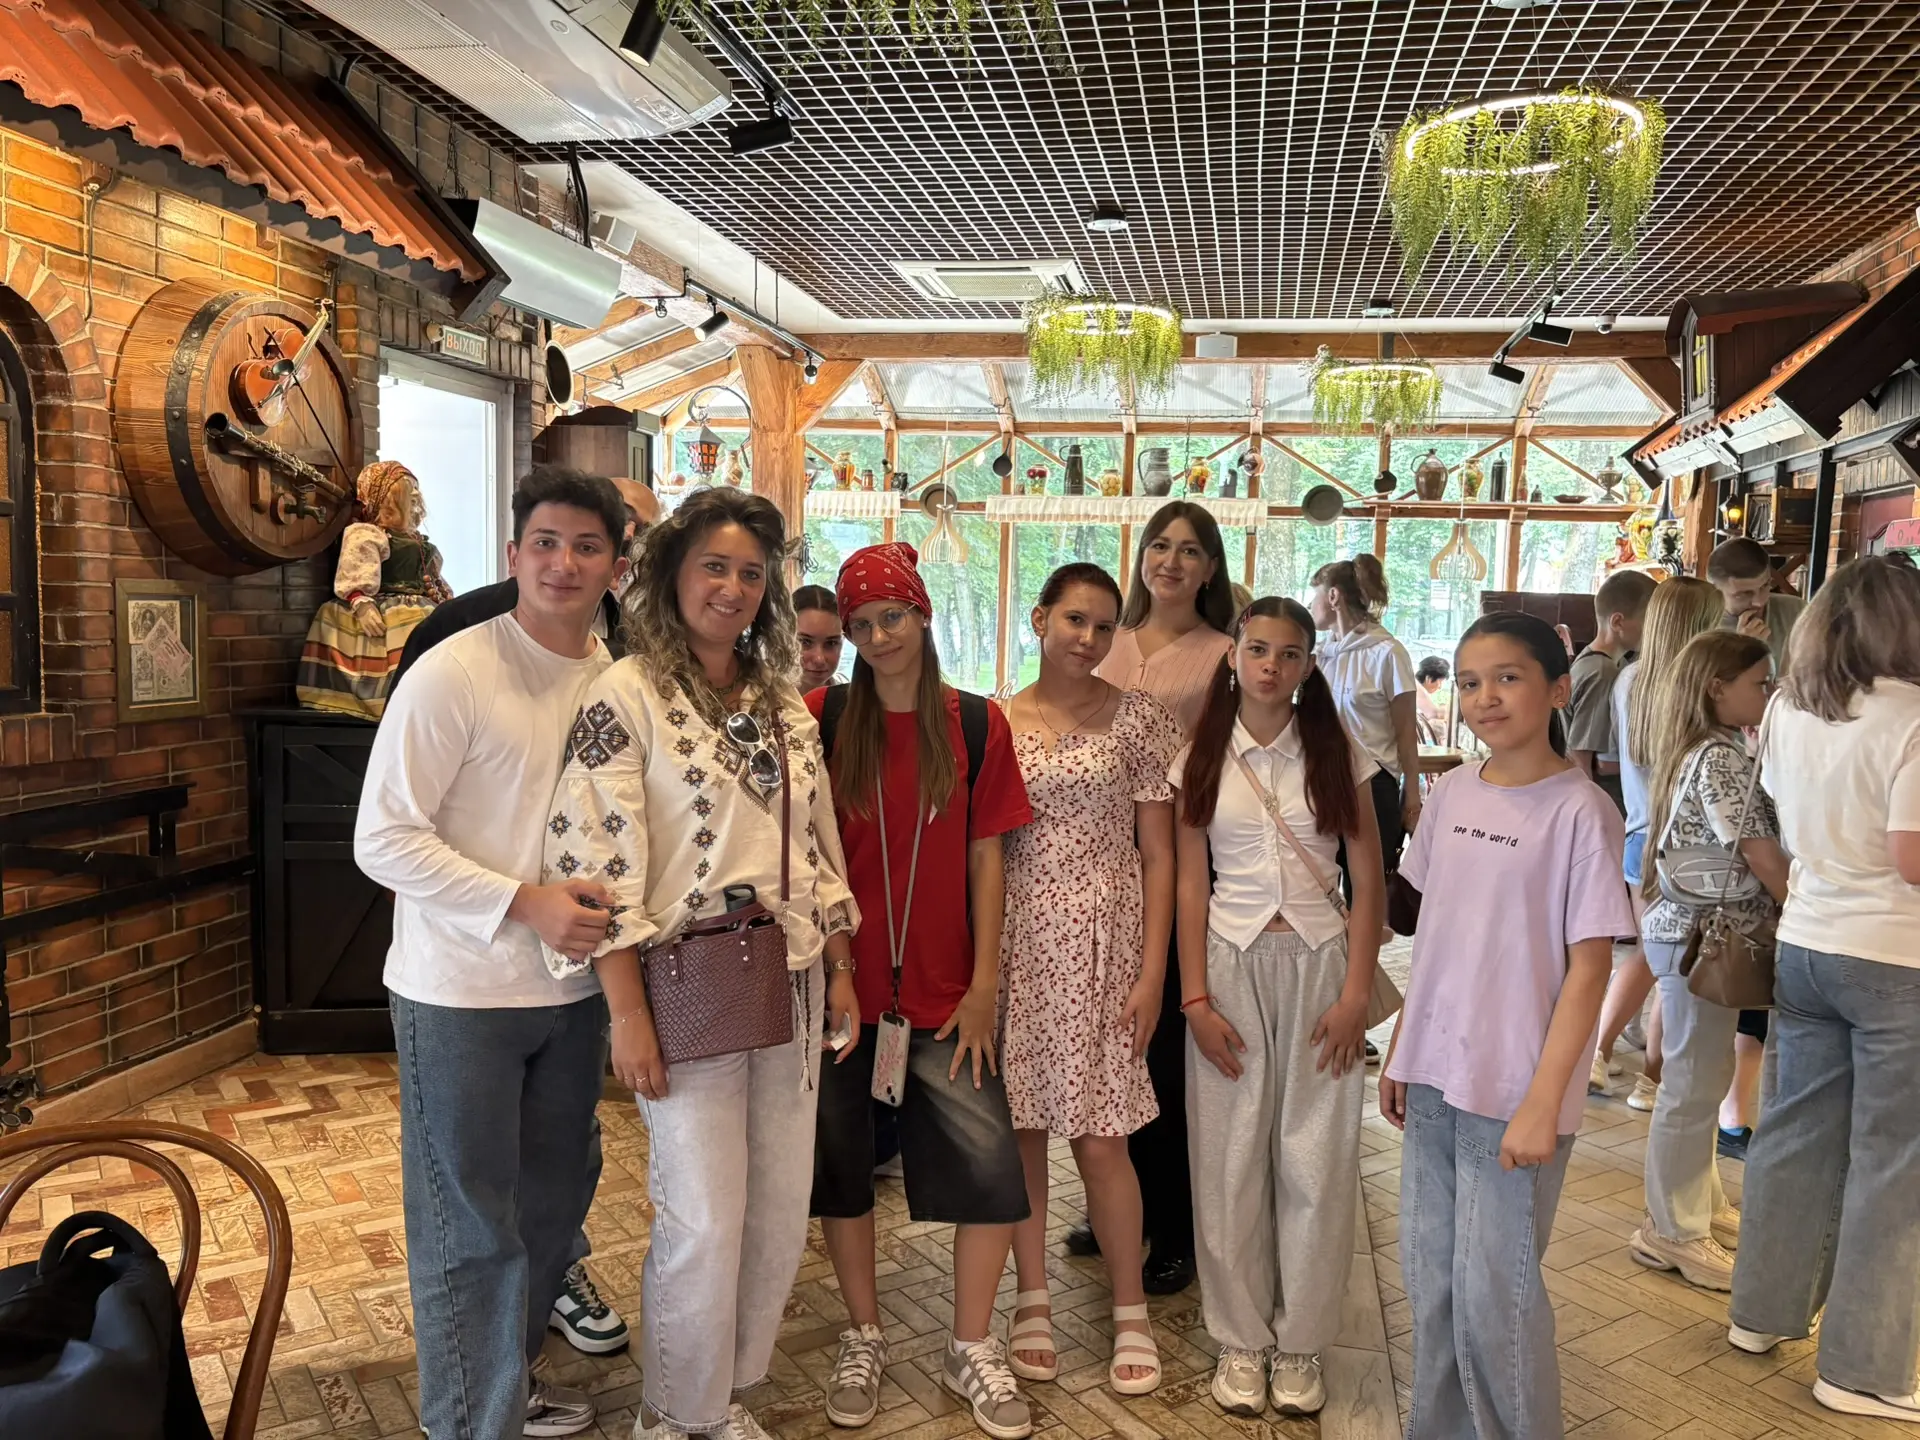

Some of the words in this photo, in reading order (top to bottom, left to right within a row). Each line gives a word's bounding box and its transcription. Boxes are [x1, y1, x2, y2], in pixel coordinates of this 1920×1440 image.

[447, 334, 482, 357] ВЫХОД
[1453, 825, 1468, 835] see
[1471, 828, 1486, 839] the
[1489, 833, 1519, 848] world
